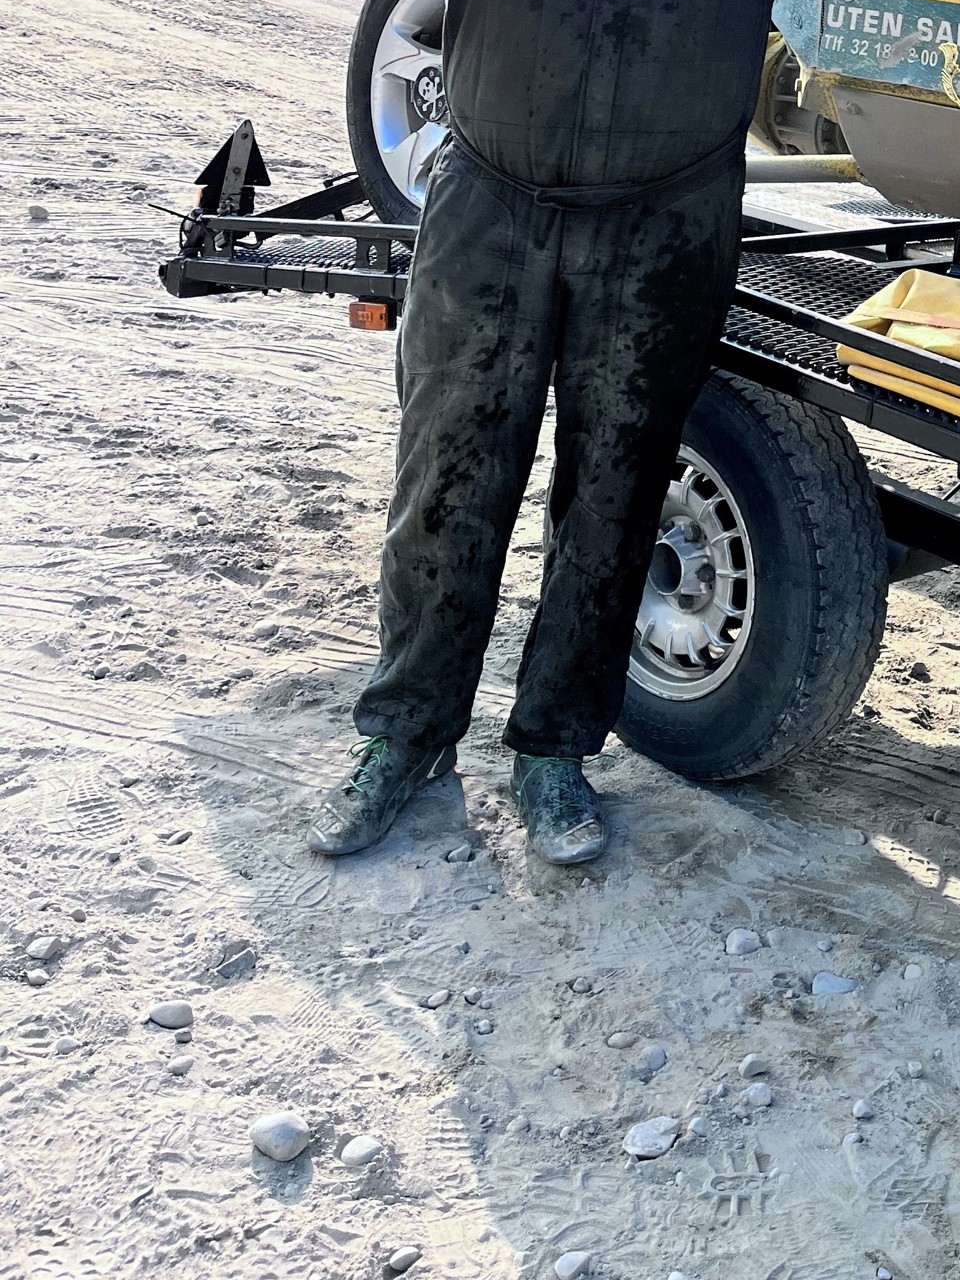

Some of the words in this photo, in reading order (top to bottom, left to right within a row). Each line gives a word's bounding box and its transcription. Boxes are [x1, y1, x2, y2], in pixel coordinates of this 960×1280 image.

[826, 3, 903, 38] UTEN
[824, 34, 845, 53] Tlf.
[850, 39, 868, 56] 32
[874, 42, 892, 59] 18
[920, 49, 939, 67] 00
